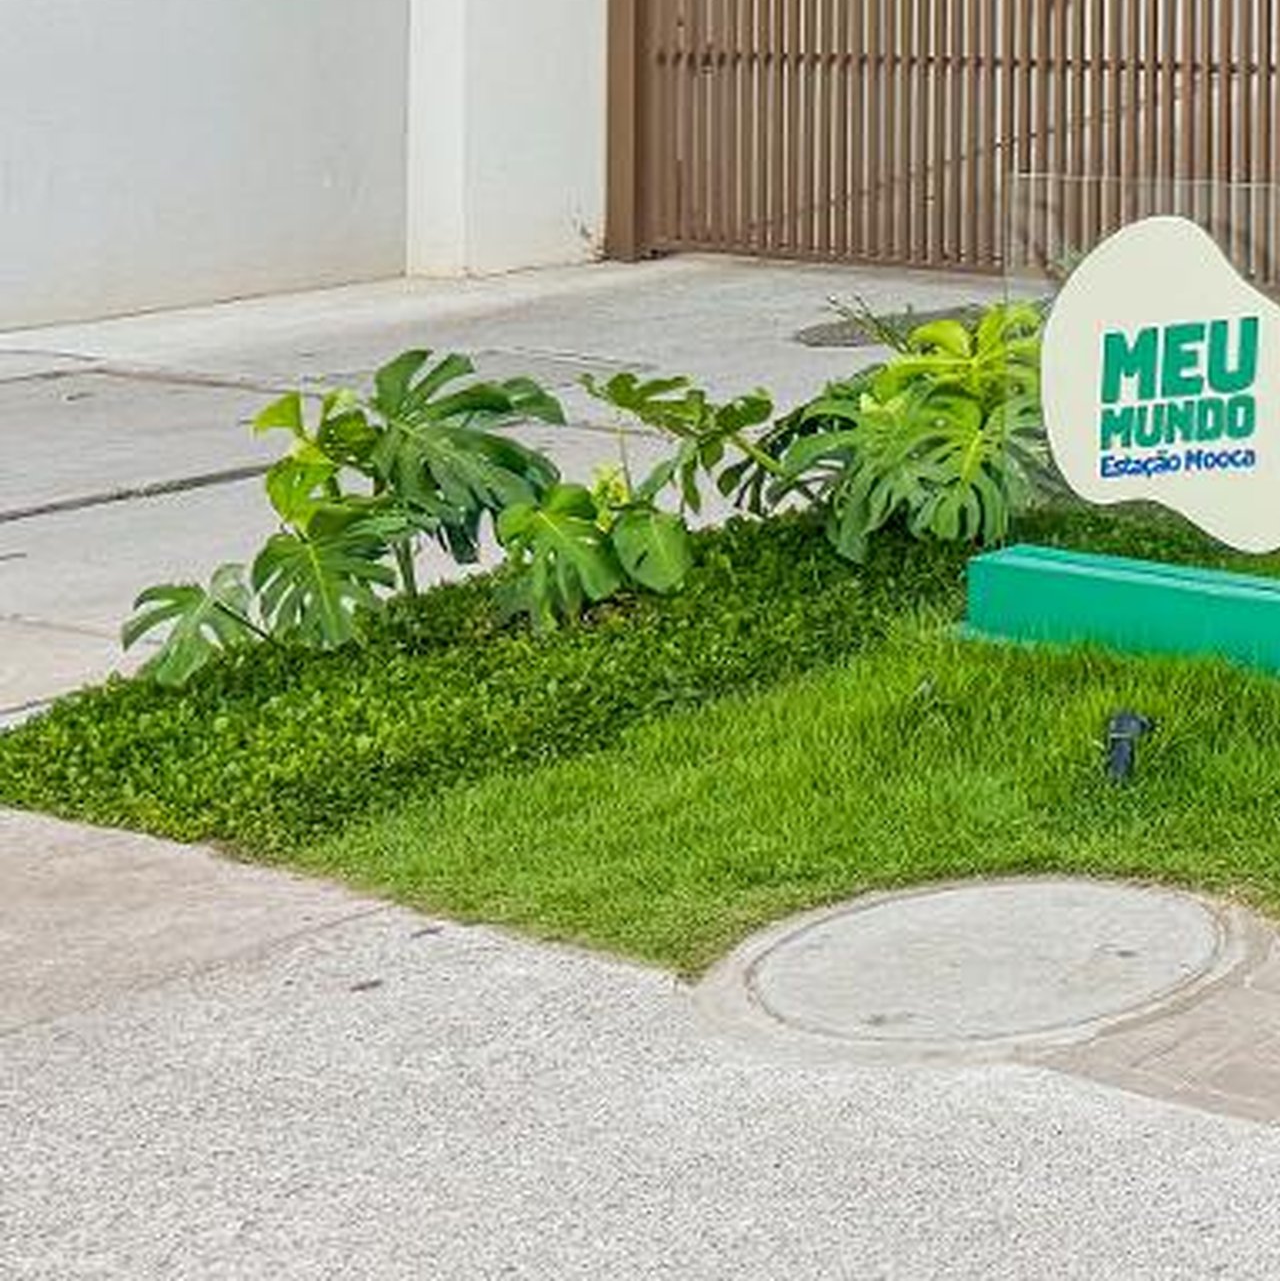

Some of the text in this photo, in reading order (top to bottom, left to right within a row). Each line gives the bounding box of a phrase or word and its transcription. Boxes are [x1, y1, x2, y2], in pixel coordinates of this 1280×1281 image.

[1101, 317, 1259, 403] MEU
[1101, 395, 1256, 450] MUNDO
[1100, 449, 1182, 478] Estação
